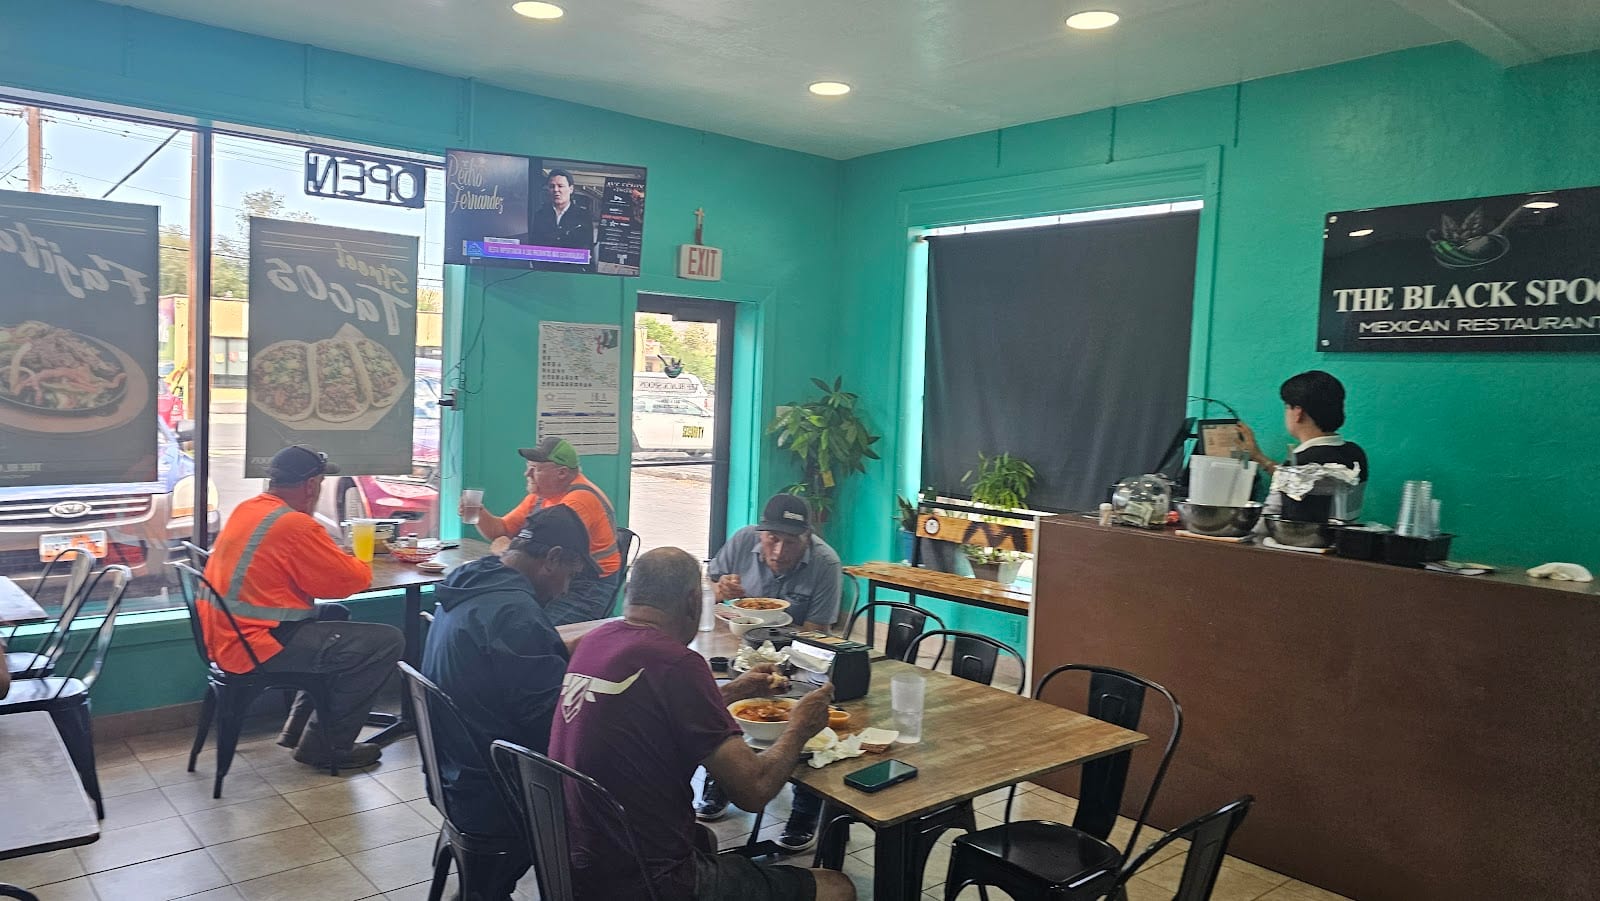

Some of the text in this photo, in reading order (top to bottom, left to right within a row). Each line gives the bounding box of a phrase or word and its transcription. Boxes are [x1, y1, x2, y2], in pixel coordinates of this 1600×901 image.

[688, 247, 718, 277] EXIT
[1333, 277, 1600, 313] THE BLACK SPO
[1359, 315, 1600, 333] MEXICAN RESTAURANT
